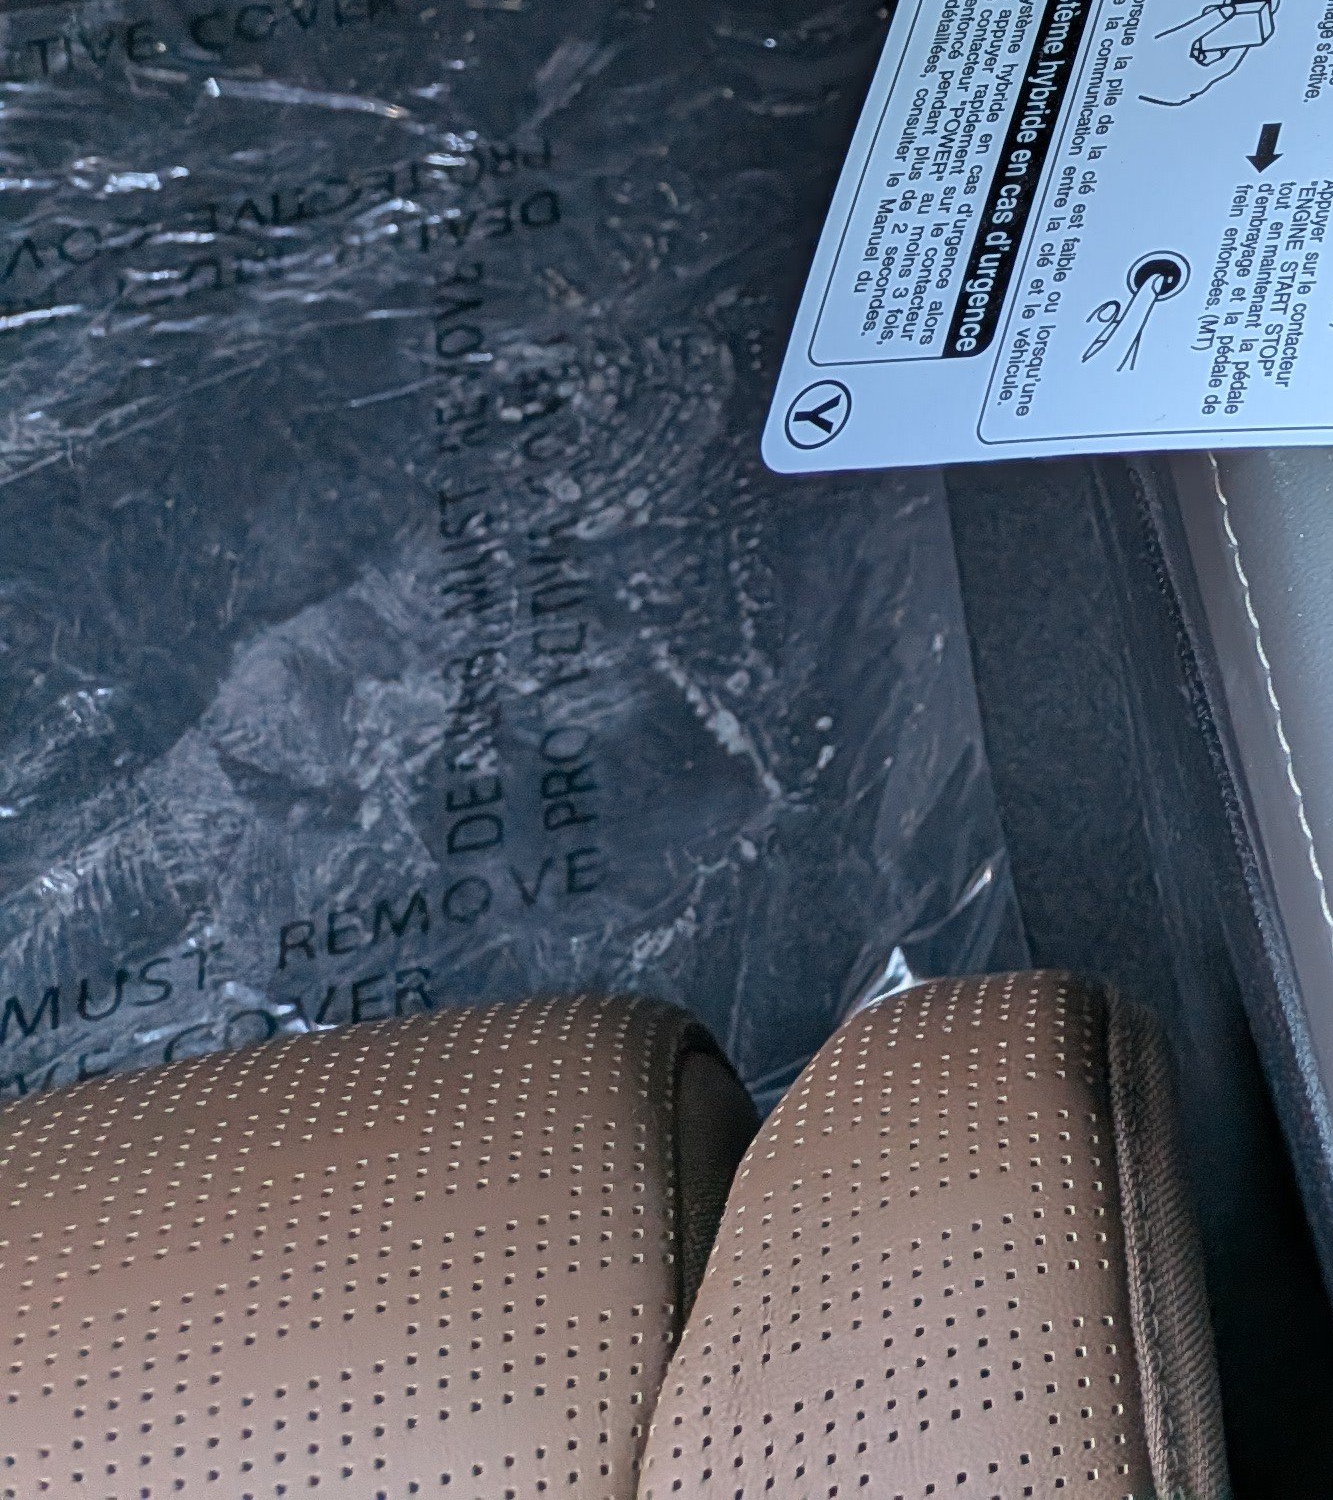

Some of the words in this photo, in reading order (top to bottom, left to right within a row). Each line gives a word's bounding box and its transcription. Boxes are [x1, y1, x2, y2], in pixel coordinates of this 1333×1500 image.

[0, 16, 162, 80] TIVE
[1302, 41, 1333, 103] s'active.
[1015, 59, 1066, 143] hybride
[893, 87, 929, 163] consulter
[885, 171, 906, 188] le
[1004, 148, 1032, 177] en
[990, 182, 1022, 224] cas
[1273, 180, 1298, 211] tout
[861, 197, 898, 262] Manuel
[1265, 220, 1284, 241] en
[852, 269, 874, 293] du
[1300, 250, 1320, 277] sur
[1228, 286, 1247, 303] et
[1243, 243, 1279, 329] maintenant
[1268, 260, 1299, 316] START
[1295, 279, 1317, 295] le
[1222, 310, 1245, 326] la
[1207, 334, 1235, 388] pédale
[1237, 337, 1260, 353] la
[1274, 301, 1307, 388] contacteur
[1200, 393, 1222, 415] de
[1223, 359, 1251, 415] pédale
[793, 392, 843, 436] Y
[0, 940, 223, 1044] MUST
[277, 844, 605, 972] REMOVE
